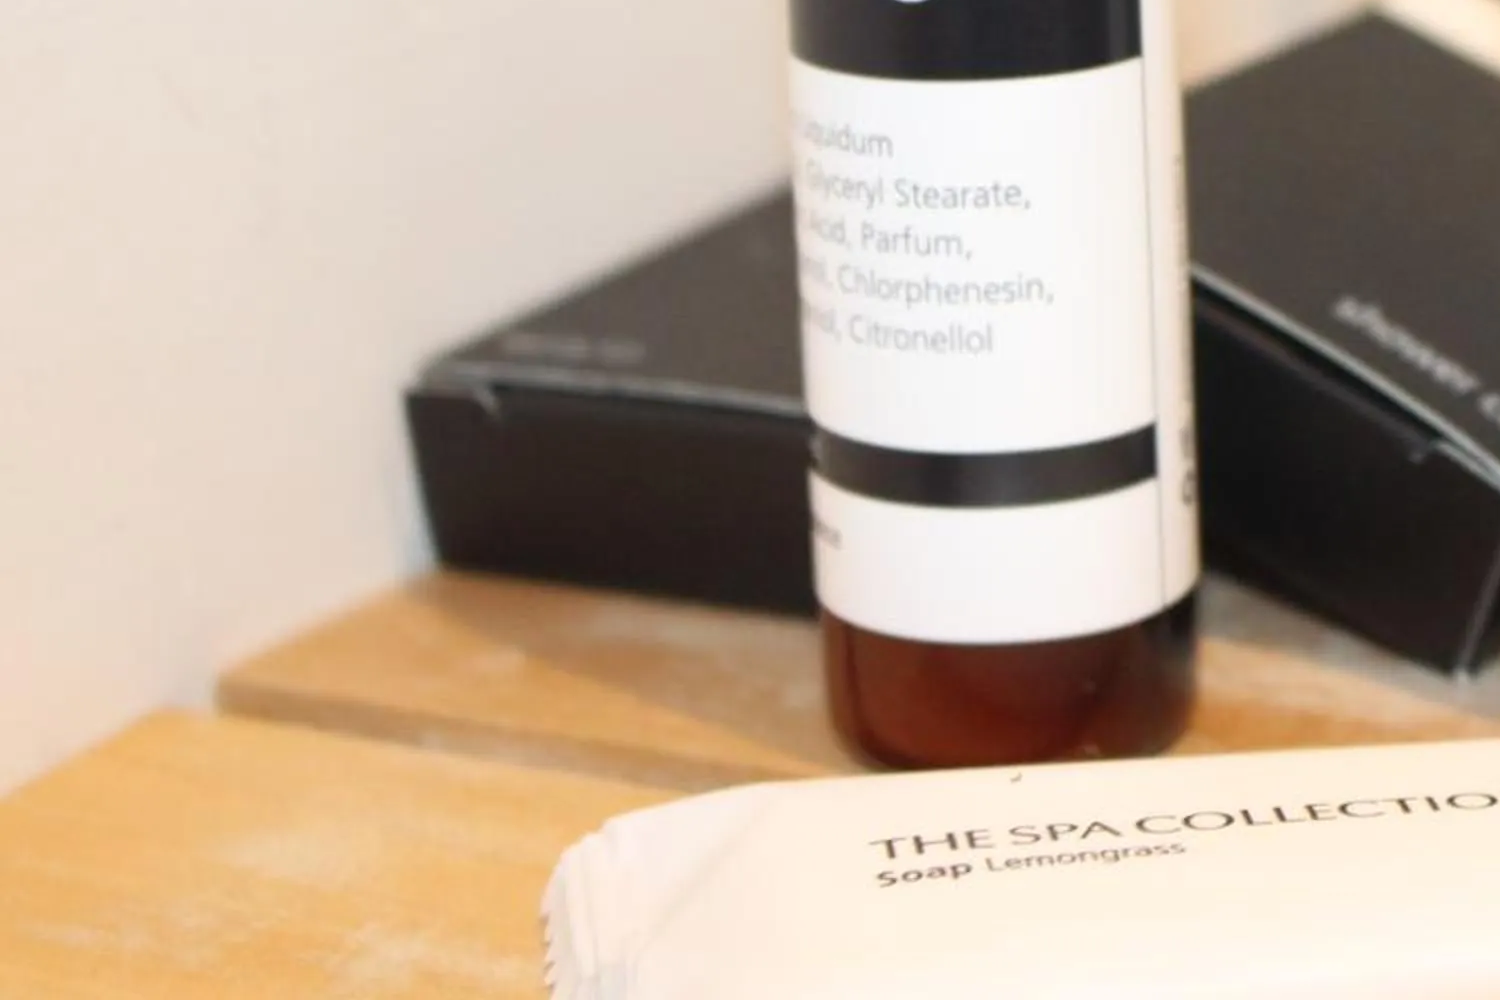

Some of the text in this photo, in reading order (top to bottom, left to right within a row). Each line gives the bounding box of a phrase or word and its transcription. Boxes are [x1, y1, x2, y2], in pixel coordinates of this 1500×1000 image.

[894, 177, 1032, 210] Stearate,
[861, 220, 973, 261] Parfum,
[837, 263, 1054, 310] Chlorphenesin,
[849, 313, 993, 354] Citronellol
[869, 828, 995, 860] THE
[1009, 820, 1123, 846] SPA
[876, 842, 1188, 888] Soap Lemongrass
